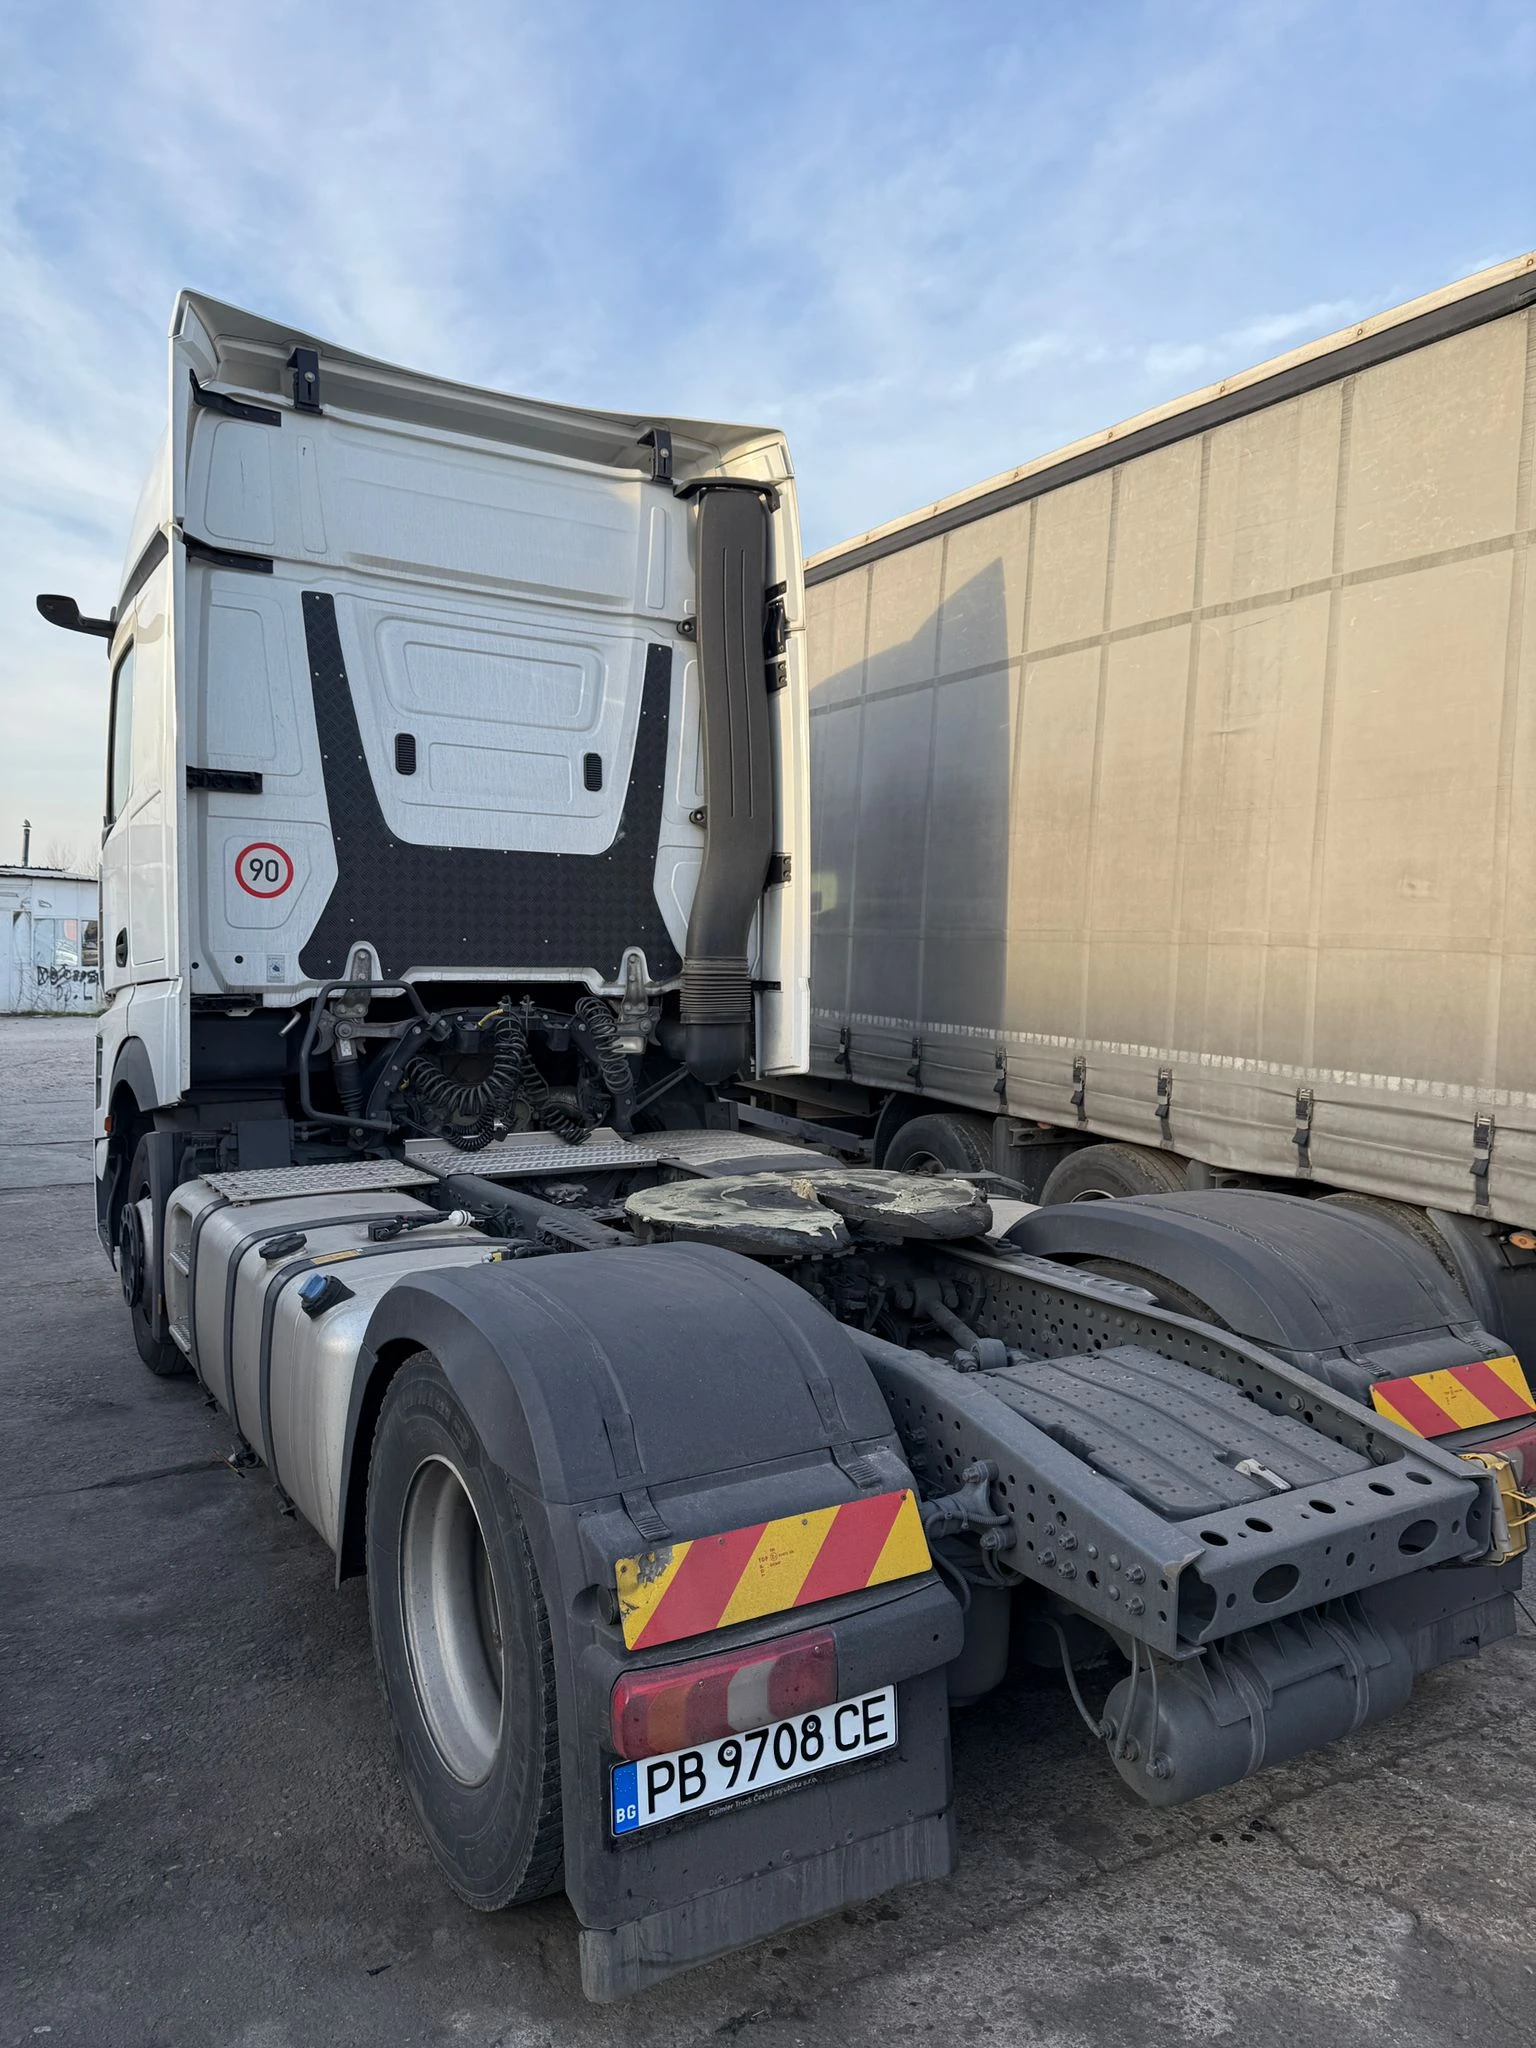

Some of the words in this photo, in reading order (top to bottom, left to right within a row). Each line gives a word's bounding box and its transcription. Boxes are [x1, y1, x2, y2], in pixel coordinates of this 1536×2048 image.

[249, 858, 279, 882] 90
[647, 1751, 706, 1814] PB
[717, 1714, 824, 1789] 9708
[834, 1694, 888, 1751] CE
[616, 1805, 636, 1823] BG
[709, 1804, 733, 1816] Daimler
[735, 1798, 752, 1807] Truck
